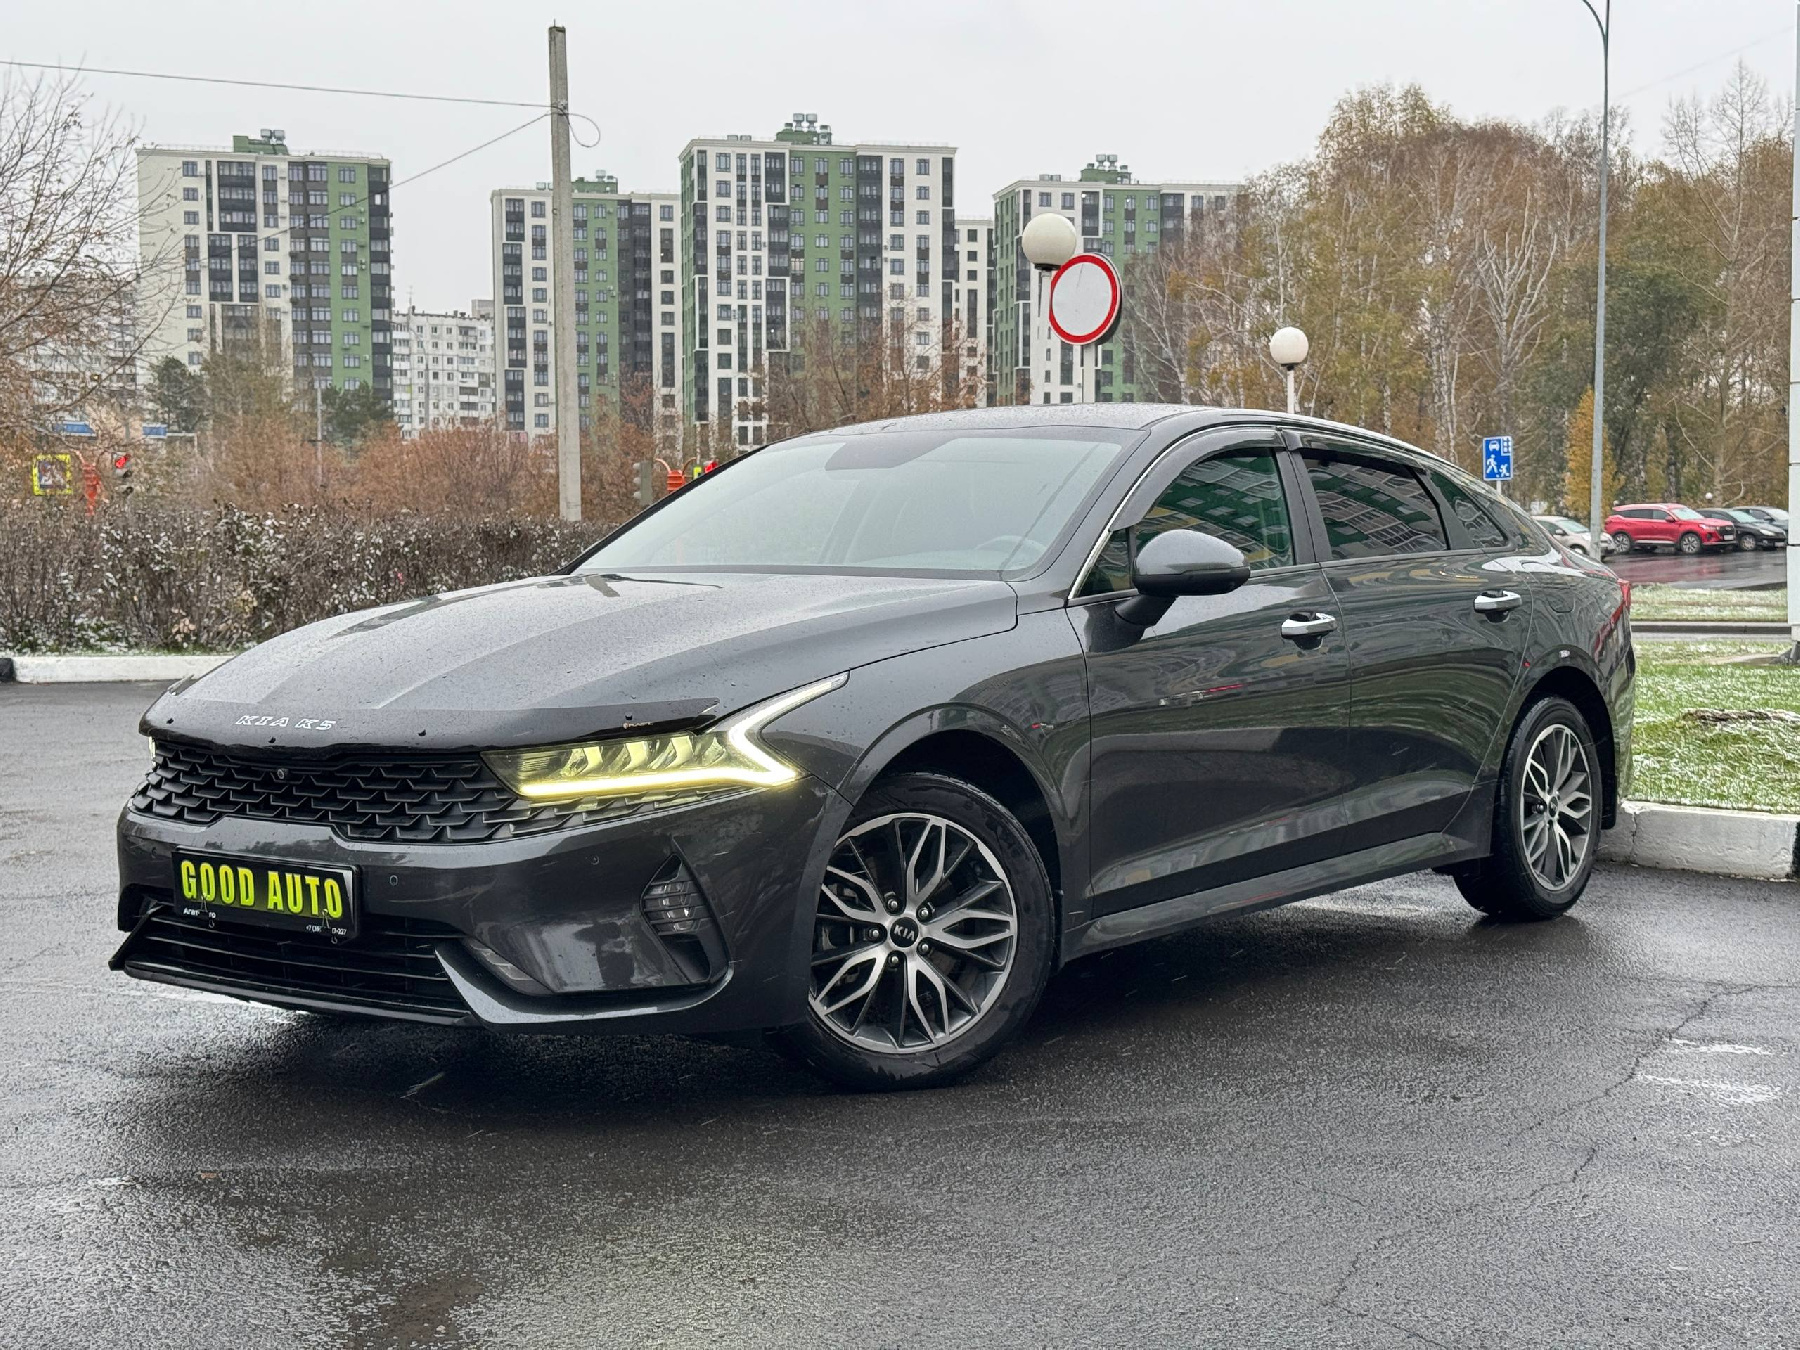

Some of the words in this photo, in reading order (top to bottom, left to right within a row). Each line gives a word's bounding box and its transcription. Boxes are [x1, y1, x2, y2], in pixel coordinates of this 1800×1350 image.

[235, 715, 289, 727] KIA
[295, 718, 336, 730] K5
[181, 860, 255, 907] GOOD
[267, 870, 343, 918] AUTO
[894, 924, 915, 941] KIA
